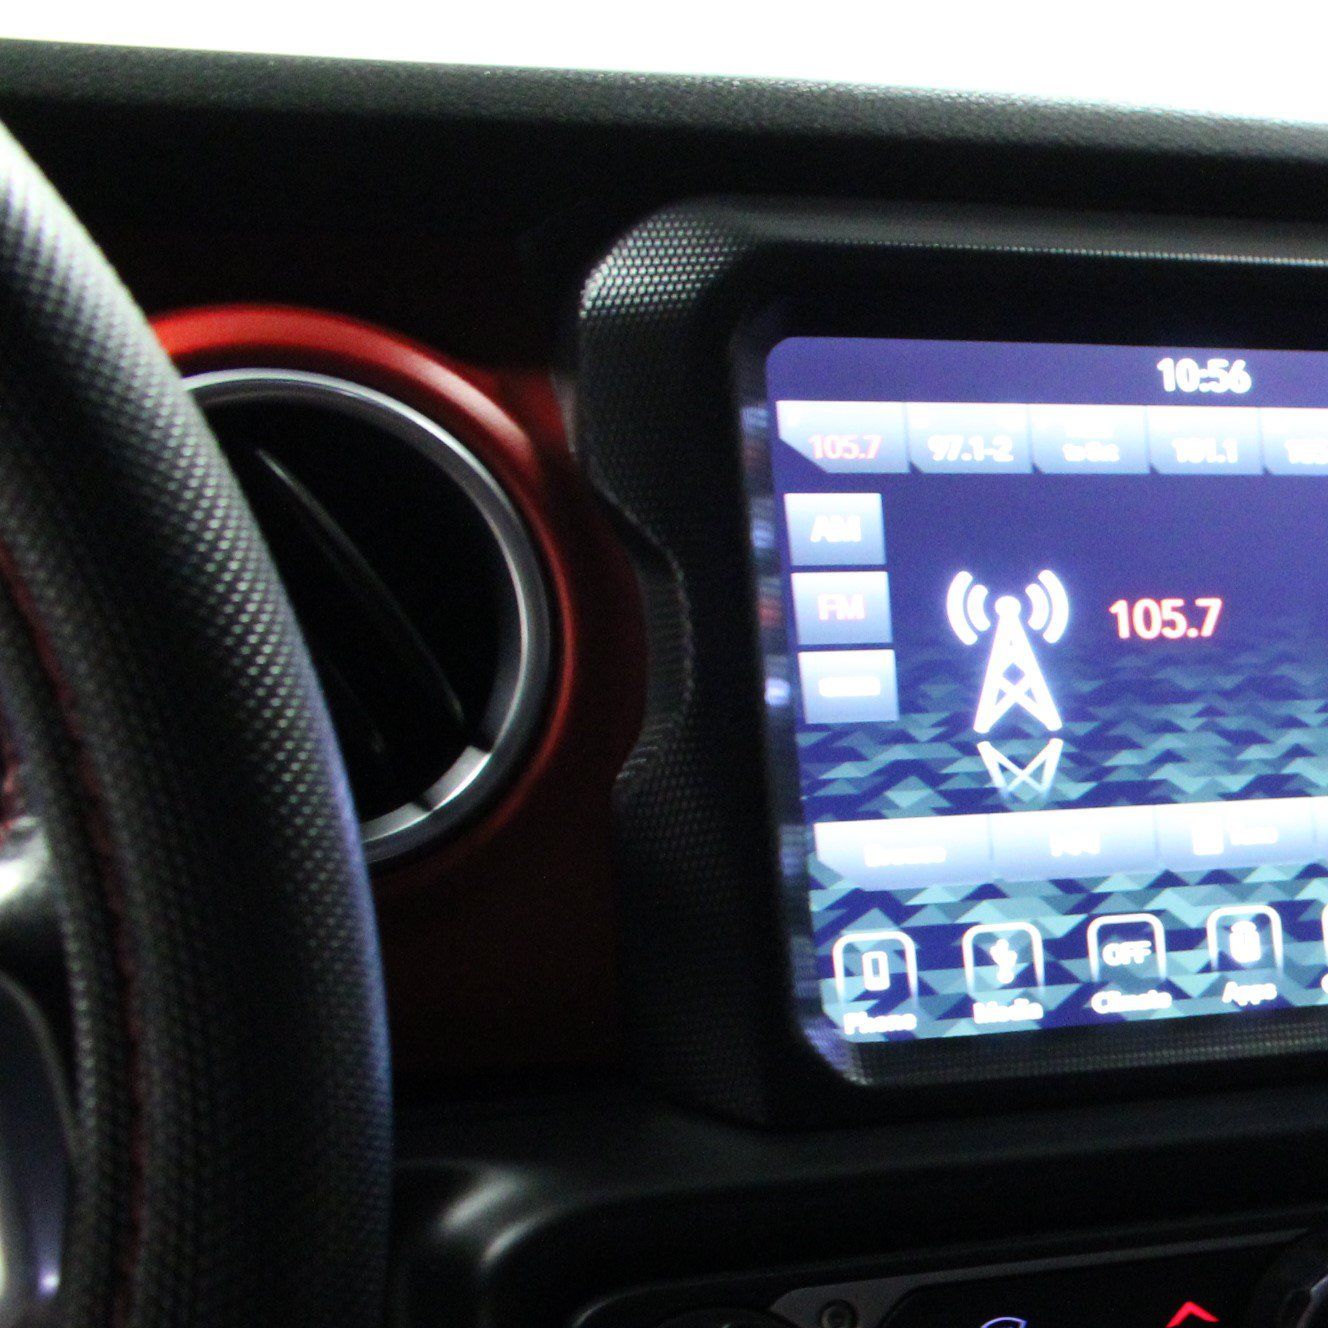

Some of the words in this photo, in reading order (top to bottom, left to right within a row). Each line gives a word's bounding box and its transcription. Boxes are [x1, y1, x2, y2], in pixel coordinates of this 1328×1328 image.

[1156, 356, 1252, 394] 10:56
[807, 433, 883, 461] 105.7
[1110, 598, 1221, 639] 105.7
[1102, 940, 1152, 967] OFF
